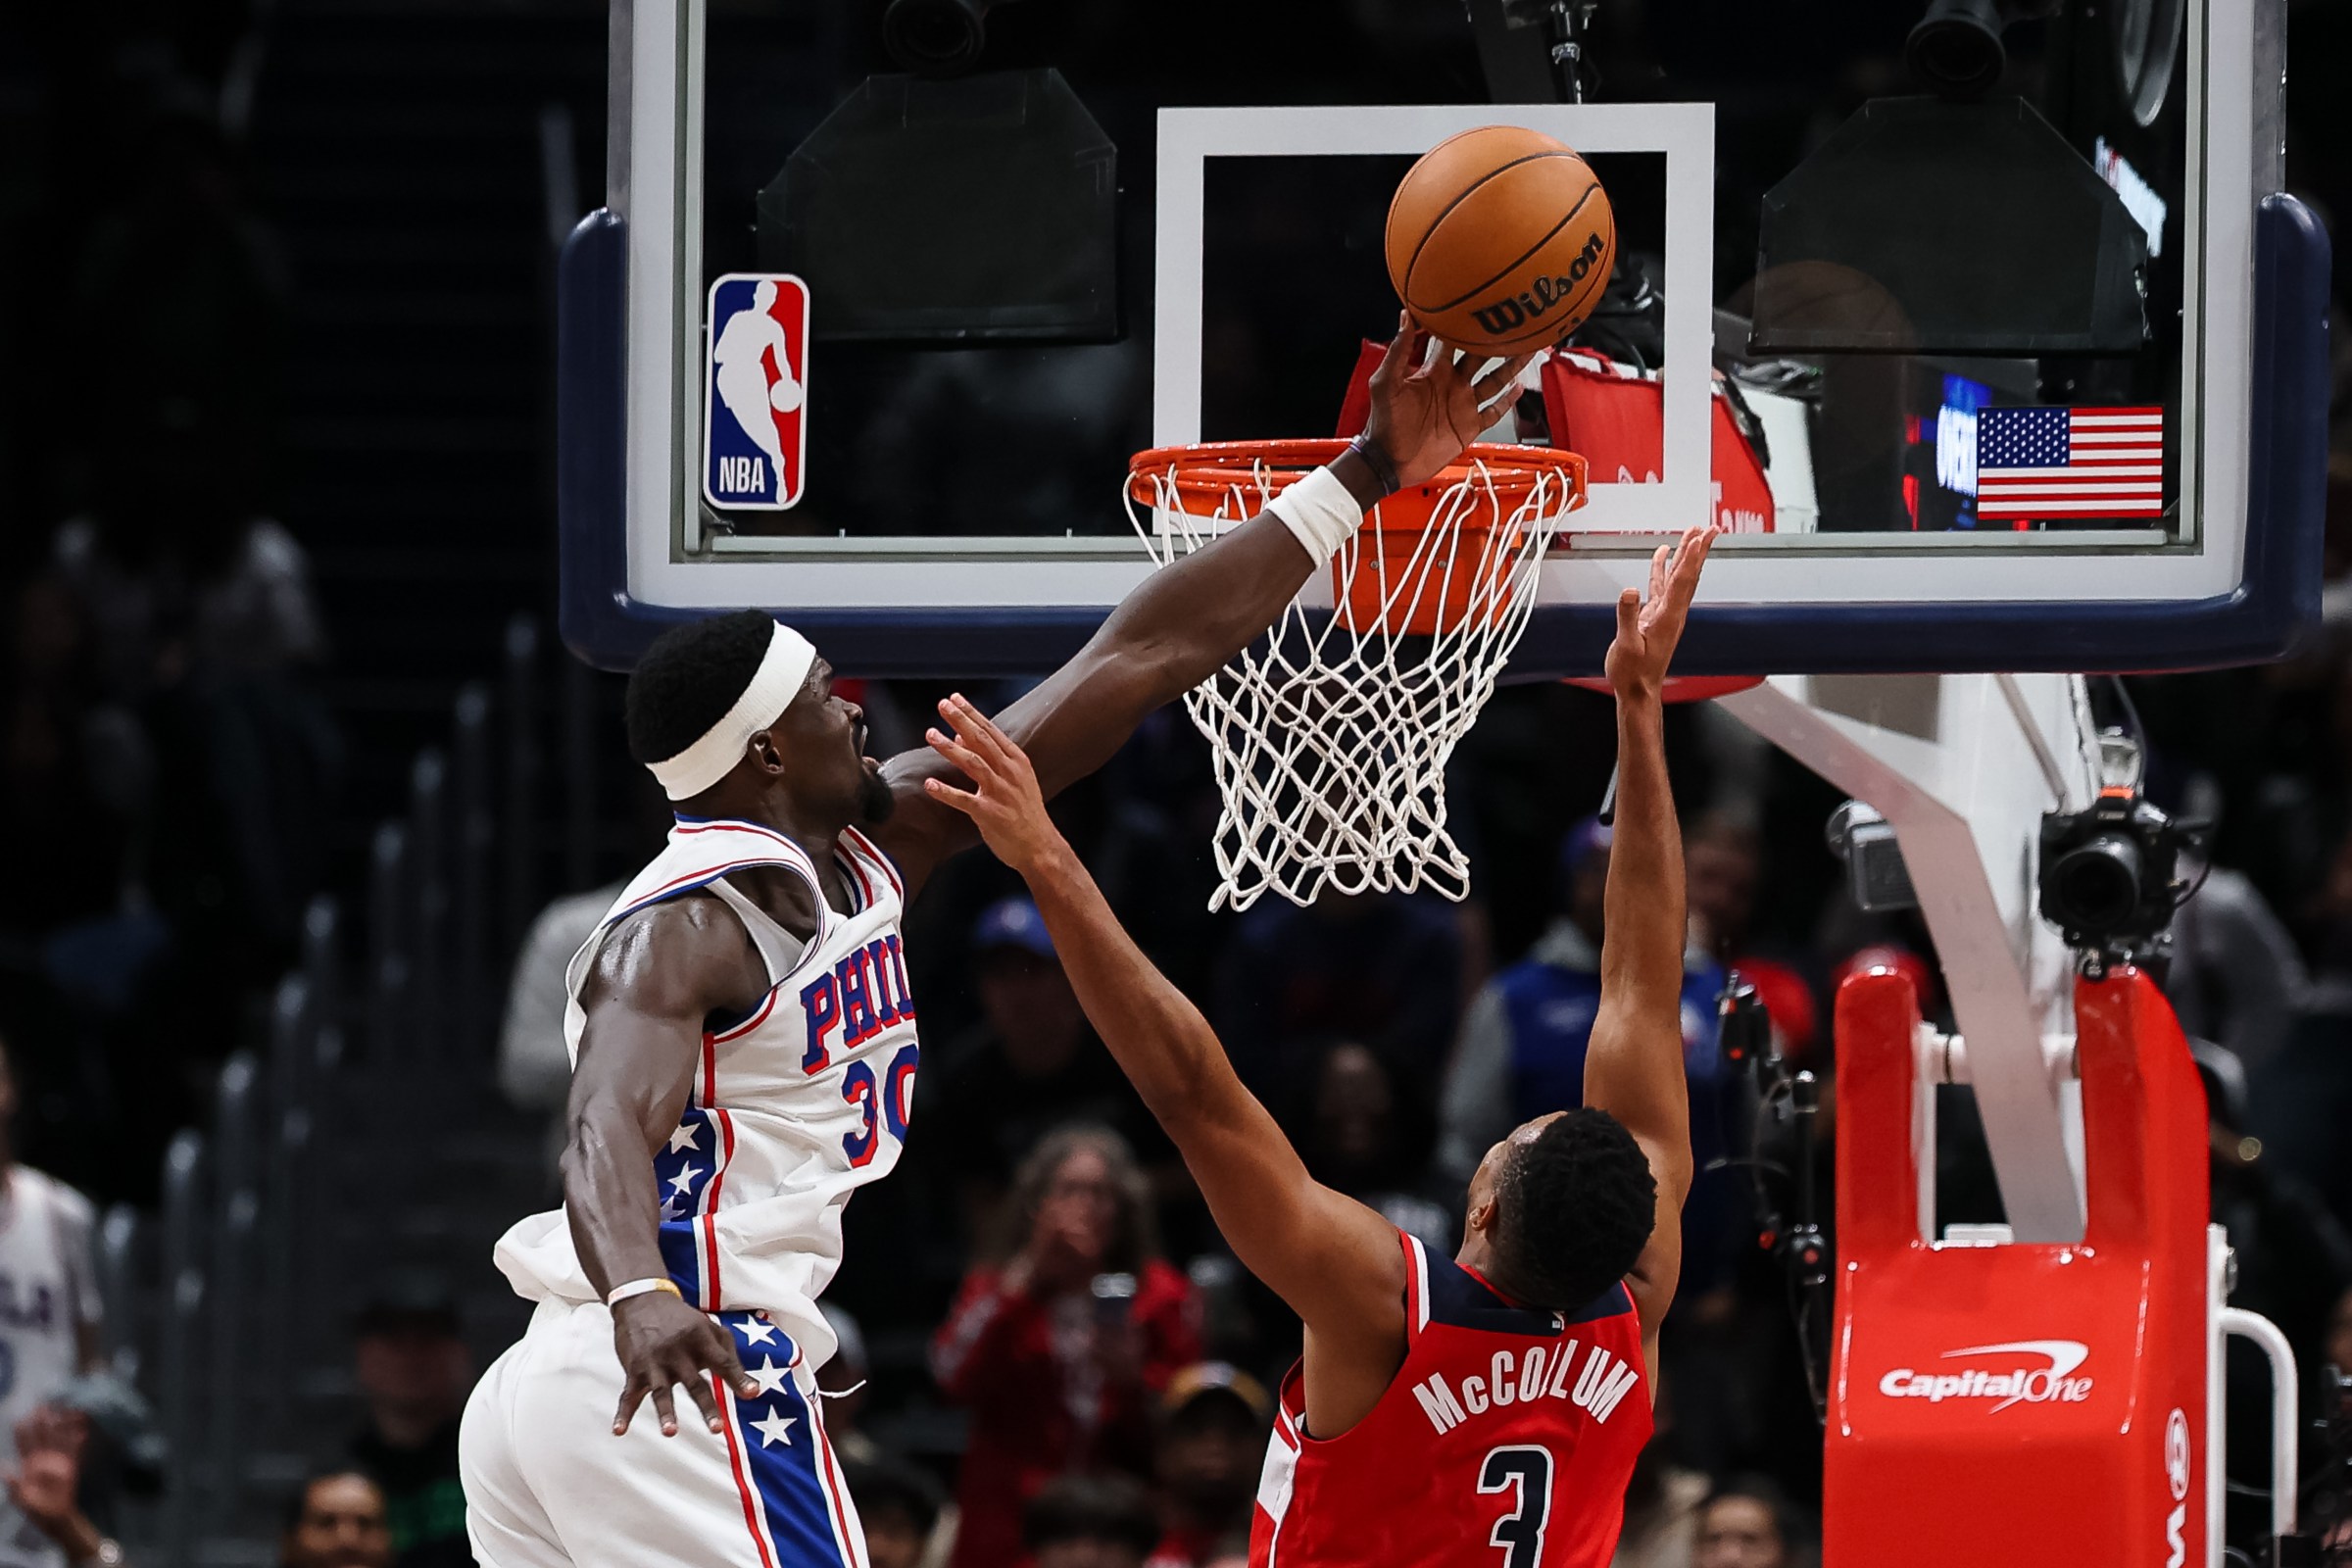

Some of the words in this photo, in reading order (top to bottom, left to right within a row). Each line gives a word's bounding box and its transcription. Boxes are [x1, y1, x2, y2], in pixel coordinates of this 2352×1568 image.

[1469, 230, 1605, 335] Wilson
[717, 455, 766, 494] NBA
[841, 1043, 919, 1169] 30
[1477, 1444, 1554, 1568] 3
